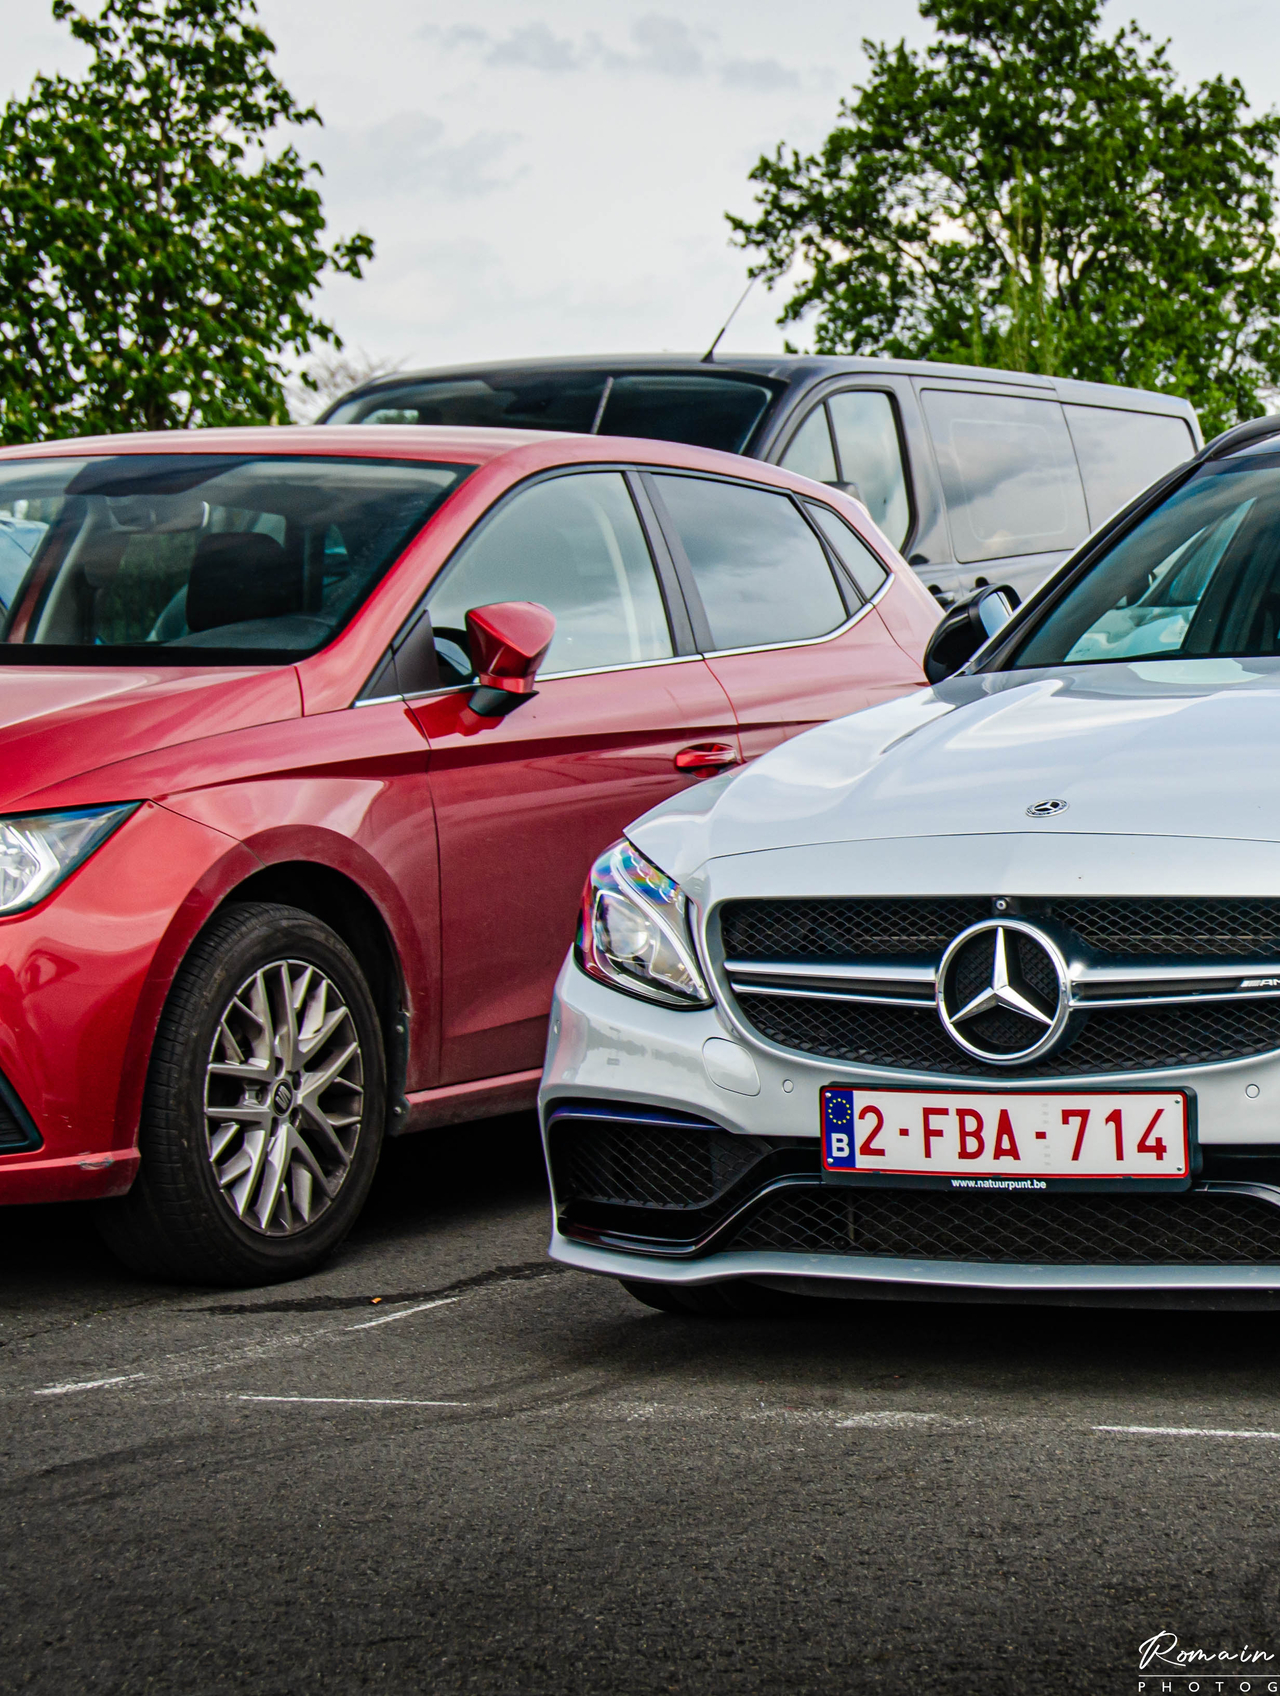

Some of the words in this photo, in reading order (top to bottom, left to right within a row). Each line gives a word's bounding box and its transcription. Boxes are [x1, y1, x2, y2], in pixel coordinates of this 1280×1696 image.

[831, 1133, 850, 1158] B
[858, 1105, 1168, 1162] 2-FBA-714
[951, 1179, 1047, 1191] www.natuurpunt.be
